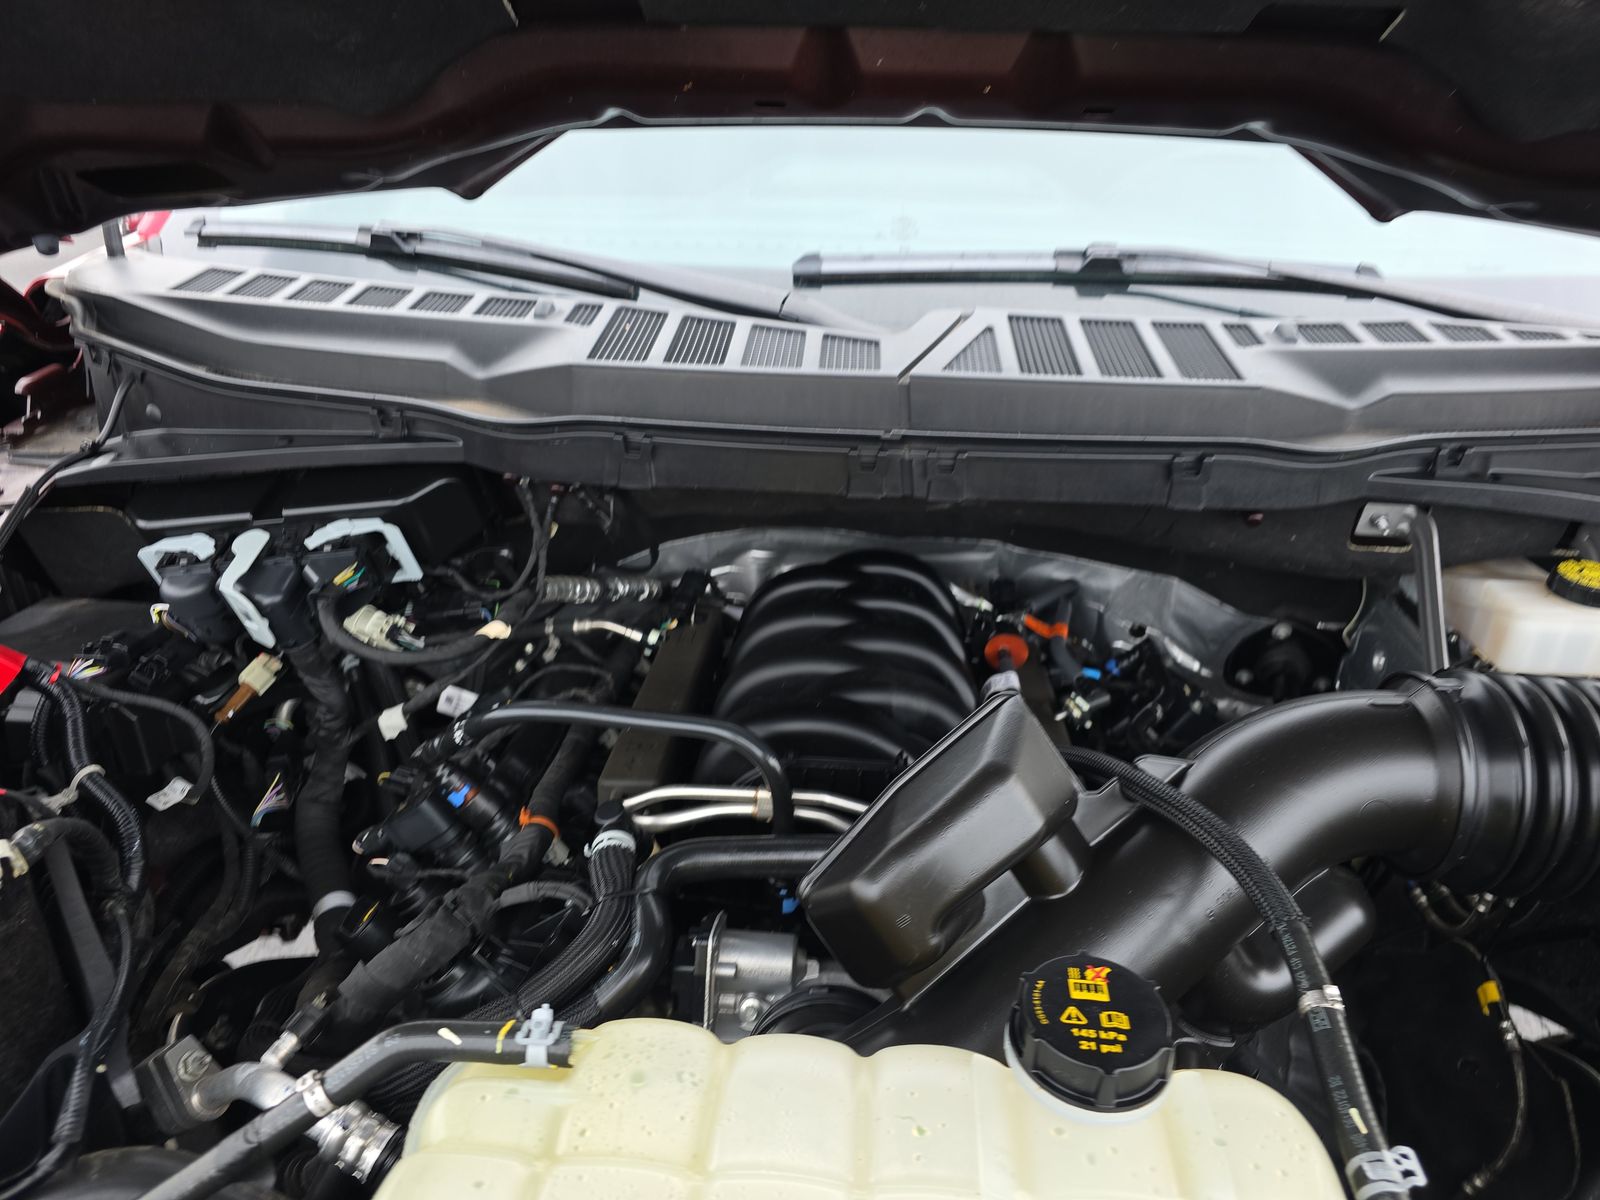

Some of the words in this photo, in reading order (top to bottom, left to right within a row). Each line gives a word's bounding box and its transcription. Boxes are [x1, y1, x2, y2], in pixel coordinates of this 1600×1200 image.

[1070, 1027, 1098, 1038] 145
[1098, 1029, 1128, 1041] kPa
[1078, 1040, 1097, 1050] 21
[1099, 1043, 1123, 1053] psi
